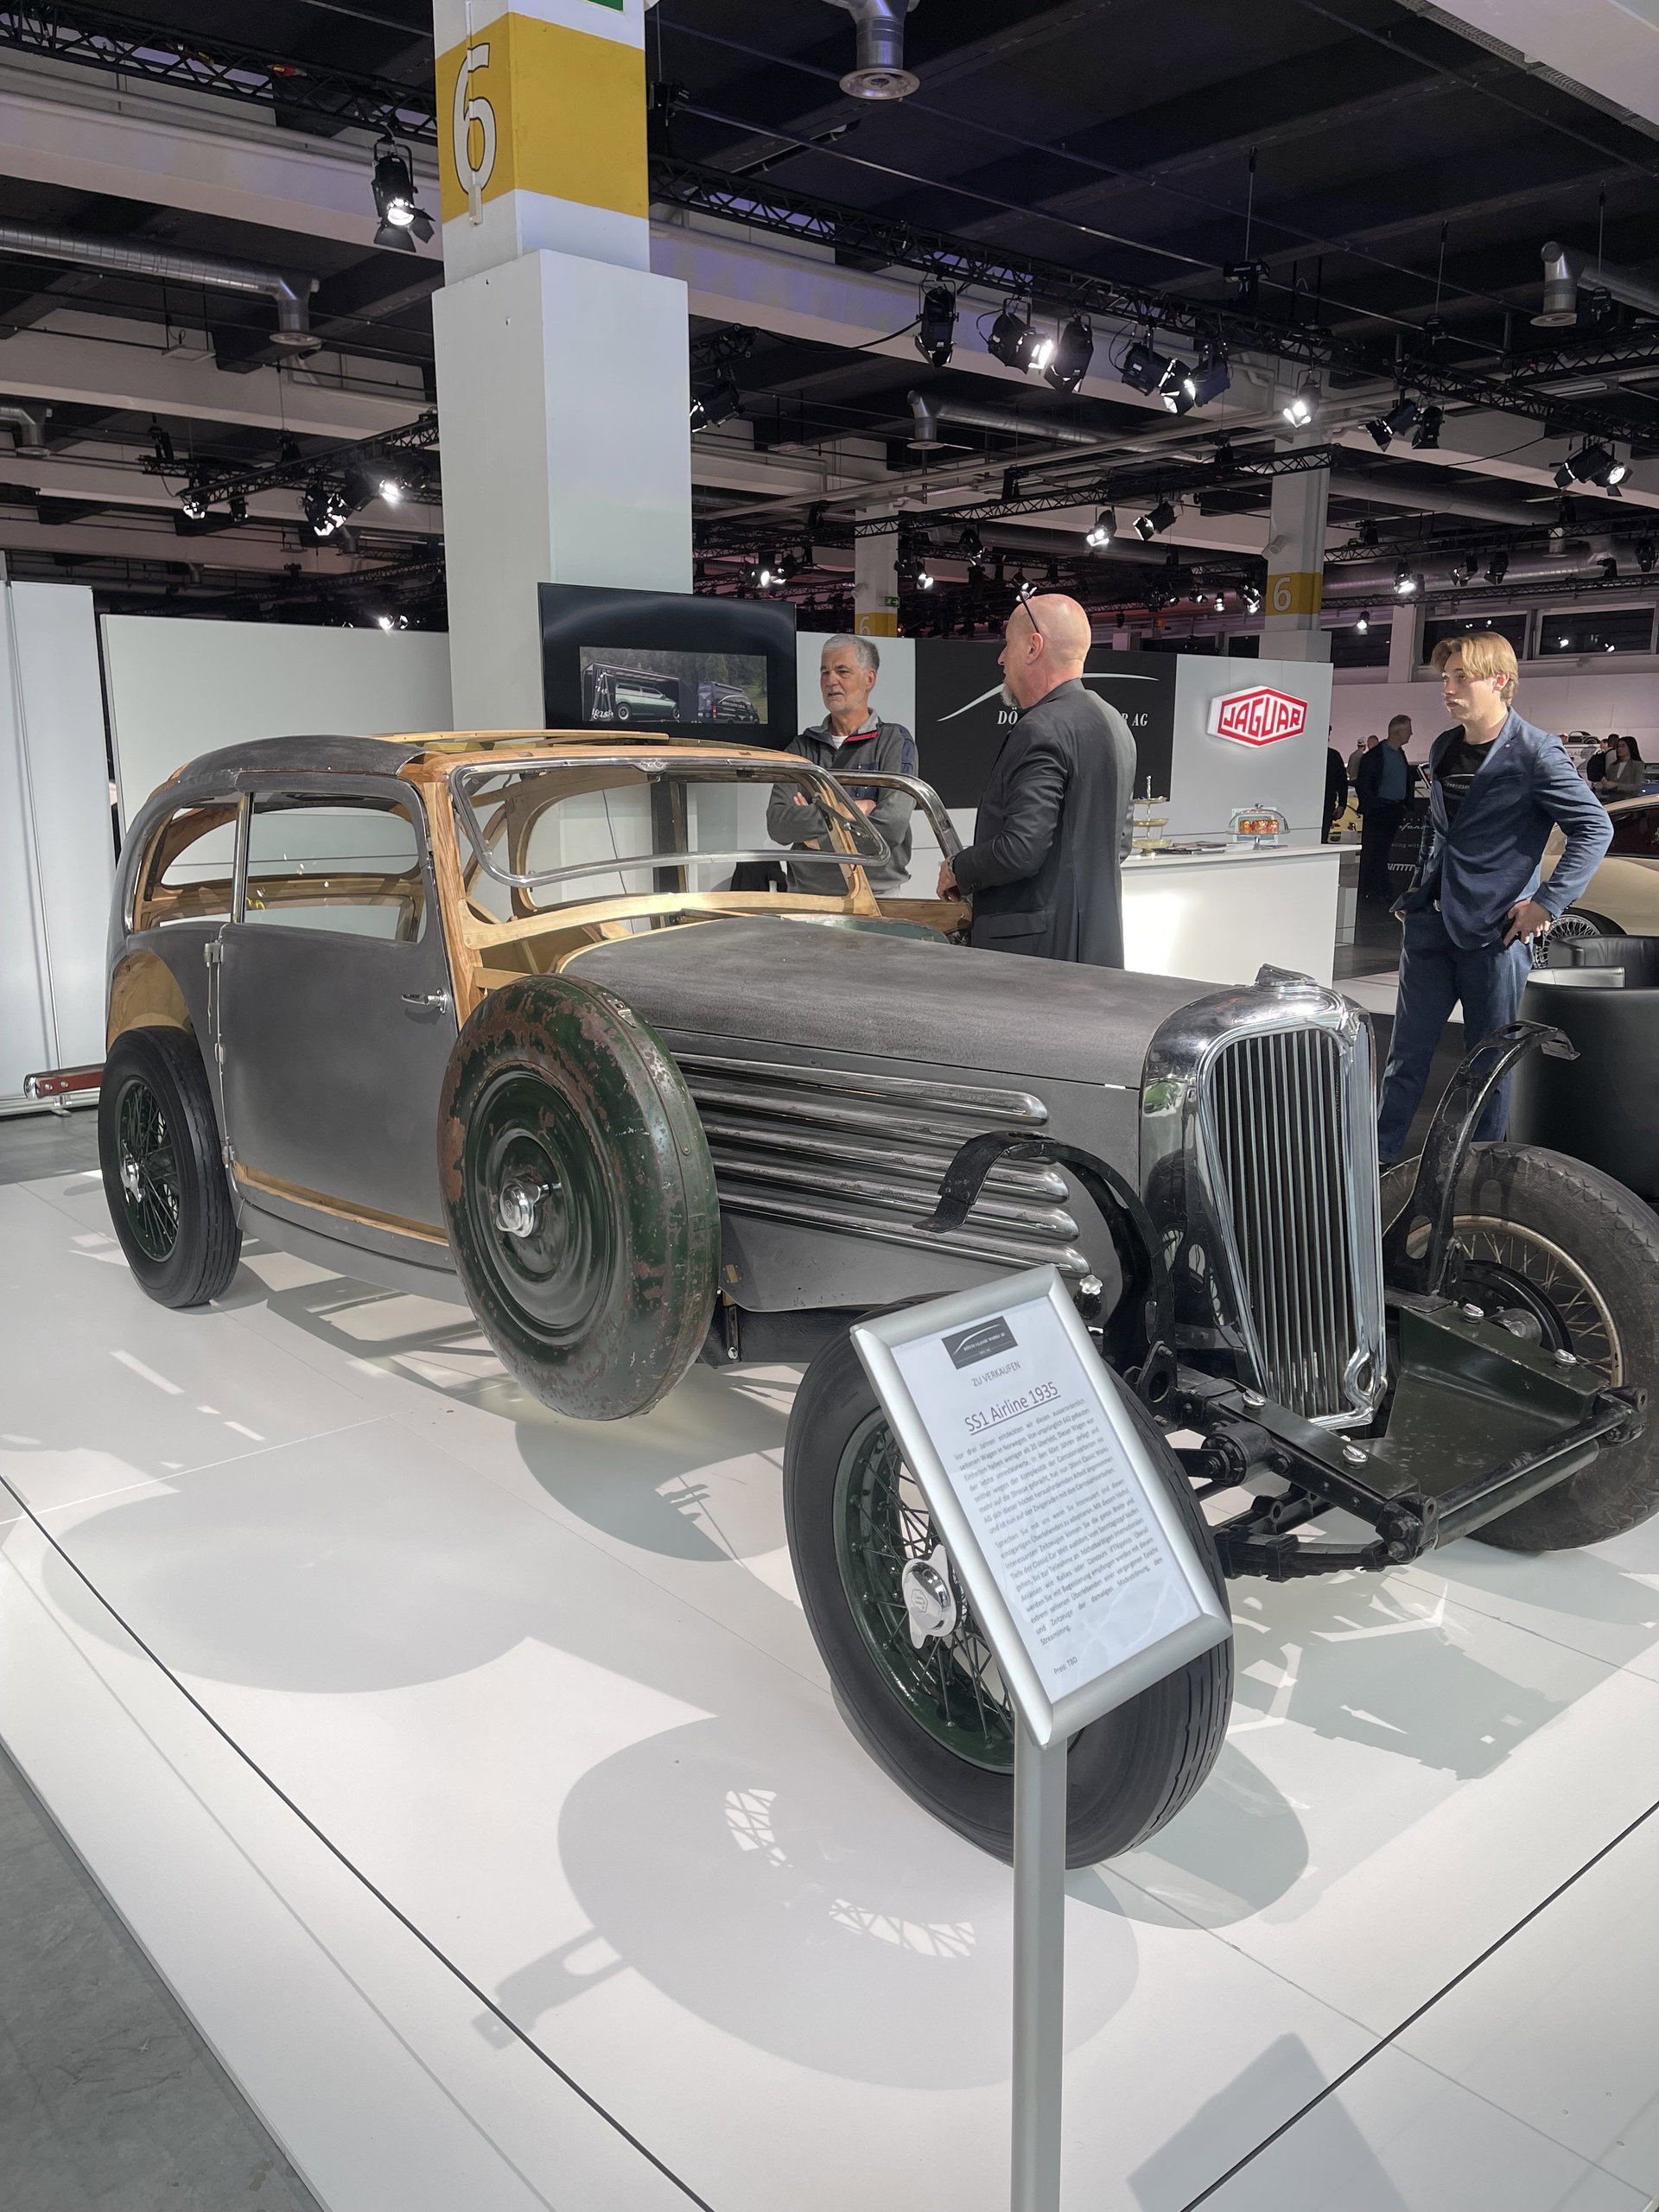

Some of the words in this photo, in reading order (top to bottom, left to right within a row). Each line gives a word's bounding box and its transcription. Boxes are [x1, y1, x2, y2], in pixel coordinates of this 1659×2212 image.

[453, 42, 497, 195] 6
[1273, 576, 1292, 612] 6
[997, 706, 1019, 725] DÖ
[1132, 713, 1148, 727] AG
[1223, 696, 1300, 738] JAGUAR
[971, 1376, 983, 1387] ZU
[982, 1361, 1021, 1382] VERKAUFEN
[963, 1410, 989, 1432] SS1
[988, 1397, 1029, 1421] Airline
[1028, 1382, 1058, 1404] 1935
[966, 1446, 977, 1455] drei
[979, 1439, 996, 1449] Jahren
[998, 1427, 1024, 1440] entdeckten
[980, 1451, 998, 1461] Wagen
[988, 1460, 1004, 1470] haben
[1004, 1451, 1023, 1463] weniger
[1058, 1429, 1071, 1438] Dieser
[1071, 1422, 1087, 1432] Wagen
[980, 1477, 995, 1486] letzte
[1060, 1440, 1075, 1449] Jahren
[983, 1515, 992, 1523] AG
[993, 1510, 1002, 1519] sich
[1002, 1503, 1018, 1514] dieser
[1018, 1495, 1034, 1506] höchst
[1073, 1469, 1087, 1479] Arbeit
[993, 1483, 1009, 1493] wegen
[993, 1497, 1003, 1506] auf
[989, 1524, 1000, 1534] und
[995, 1534, 1019, 1548] Sprechen
[1052, 1510, 1065, 1519] wenn
[1101, 1485, 1110, 1494] sind
[1030, 1523, 1064, 1542] Überlebenden
[1116, 1489, 1130, 1499] höchst
[1032, 1557, 1049, 1568] Classic
[1057, 1546, 1069, 1555] Welt
[1125, 1509, 1140, 1519] kaufen
[1039, 1535, 1065, 1551] Zeitzeugen
[1026, 1599, 1045, 1612] werden
[1062, 1573, 1091, 1592] Begeisterung
[1091, 1560, 1116, 1576] empfangen
[1116, 1551, 1132, 1562] werden
[1049, 1557, 1073, 1573] Teilnahme
[1056, 1571, 1072, 1581] Rallies
[1074, 1563, 1085, 1573] oder
[1087, 1551, 1108, 1565] Concours
[1031, 1611, 1048, 1624] extrem
[1143, 1548, 1159, 1560] Epoche
[1036, 1624, 1046, 1635] und
[1050, 1610, 1074, 1626] Zeitzeuge
[1090, 1587, 1114, 1603] damaligen
[1067, 1656, 1078, 1667] TBD
